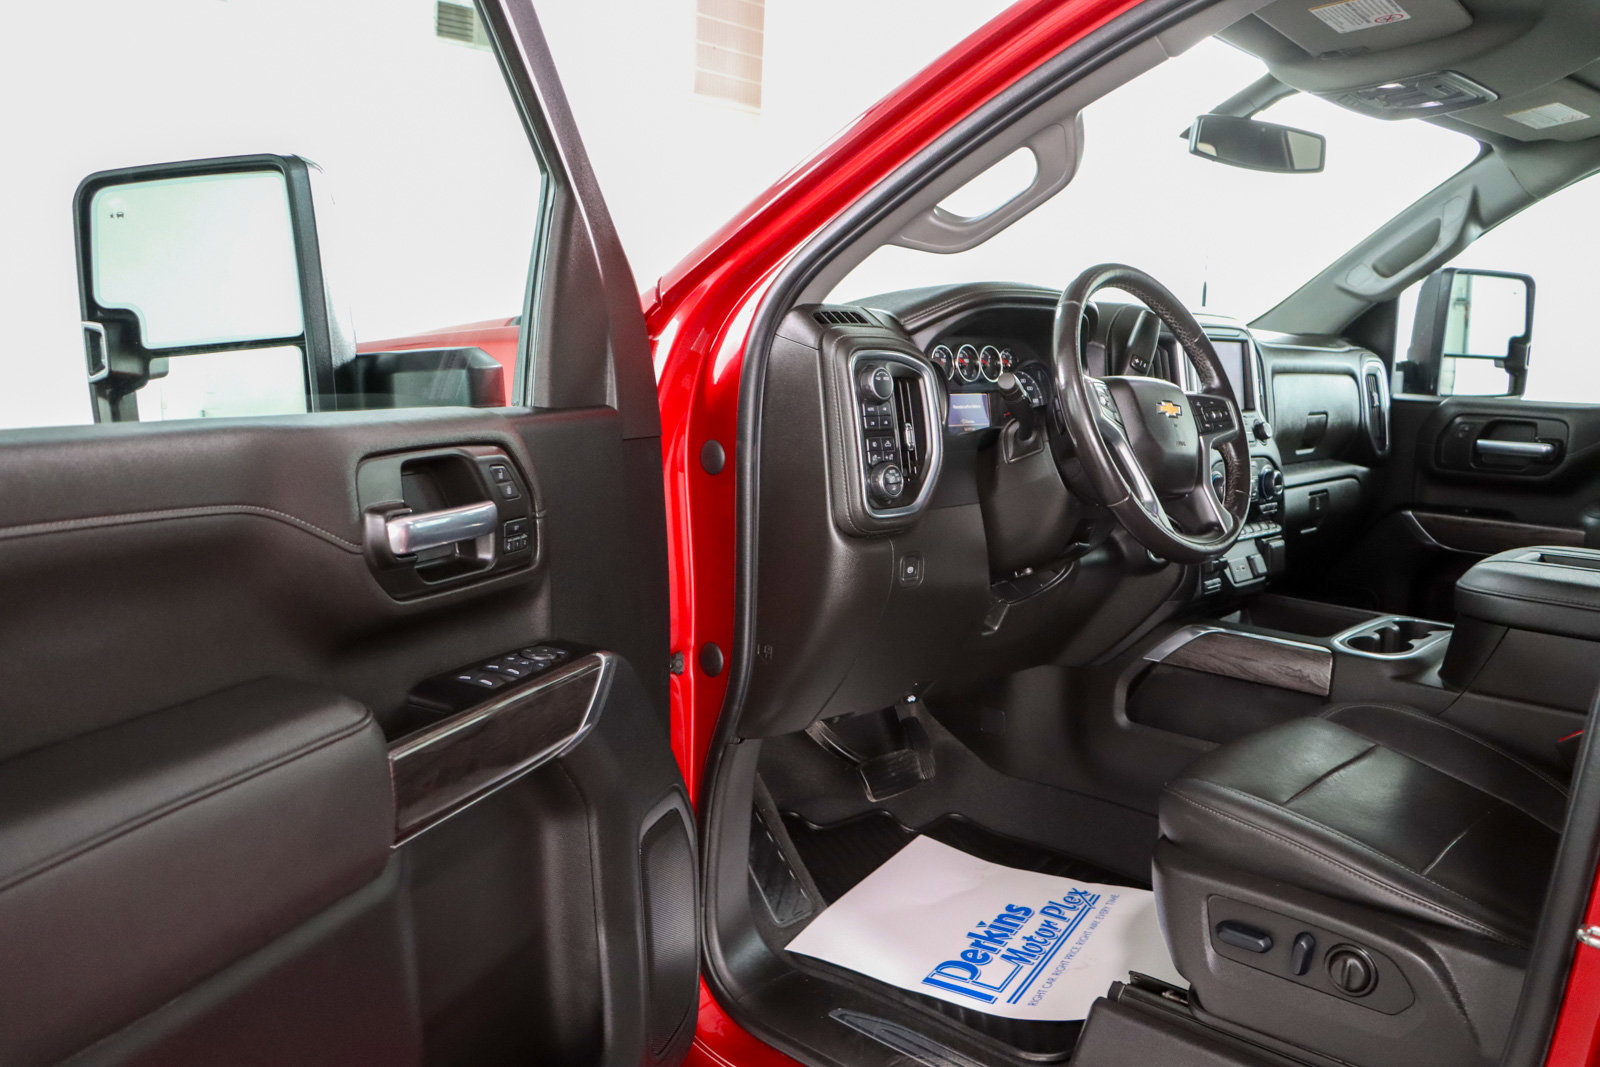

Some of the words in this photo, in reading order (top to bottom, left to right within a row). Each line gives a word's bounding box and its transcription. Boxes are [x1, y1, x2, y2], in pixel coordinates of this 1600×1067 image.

[921, 904, 1034, 1004] Perkins
[1000, 919, 1062, 966] Motor
[1039, 887, 1096, 923] Plex
[1027, 989, 1048, 1006] RIGHT
[1051, 960, 1071, 976] RIGHT
[1075, 930, 1093, 945] RIGHT
